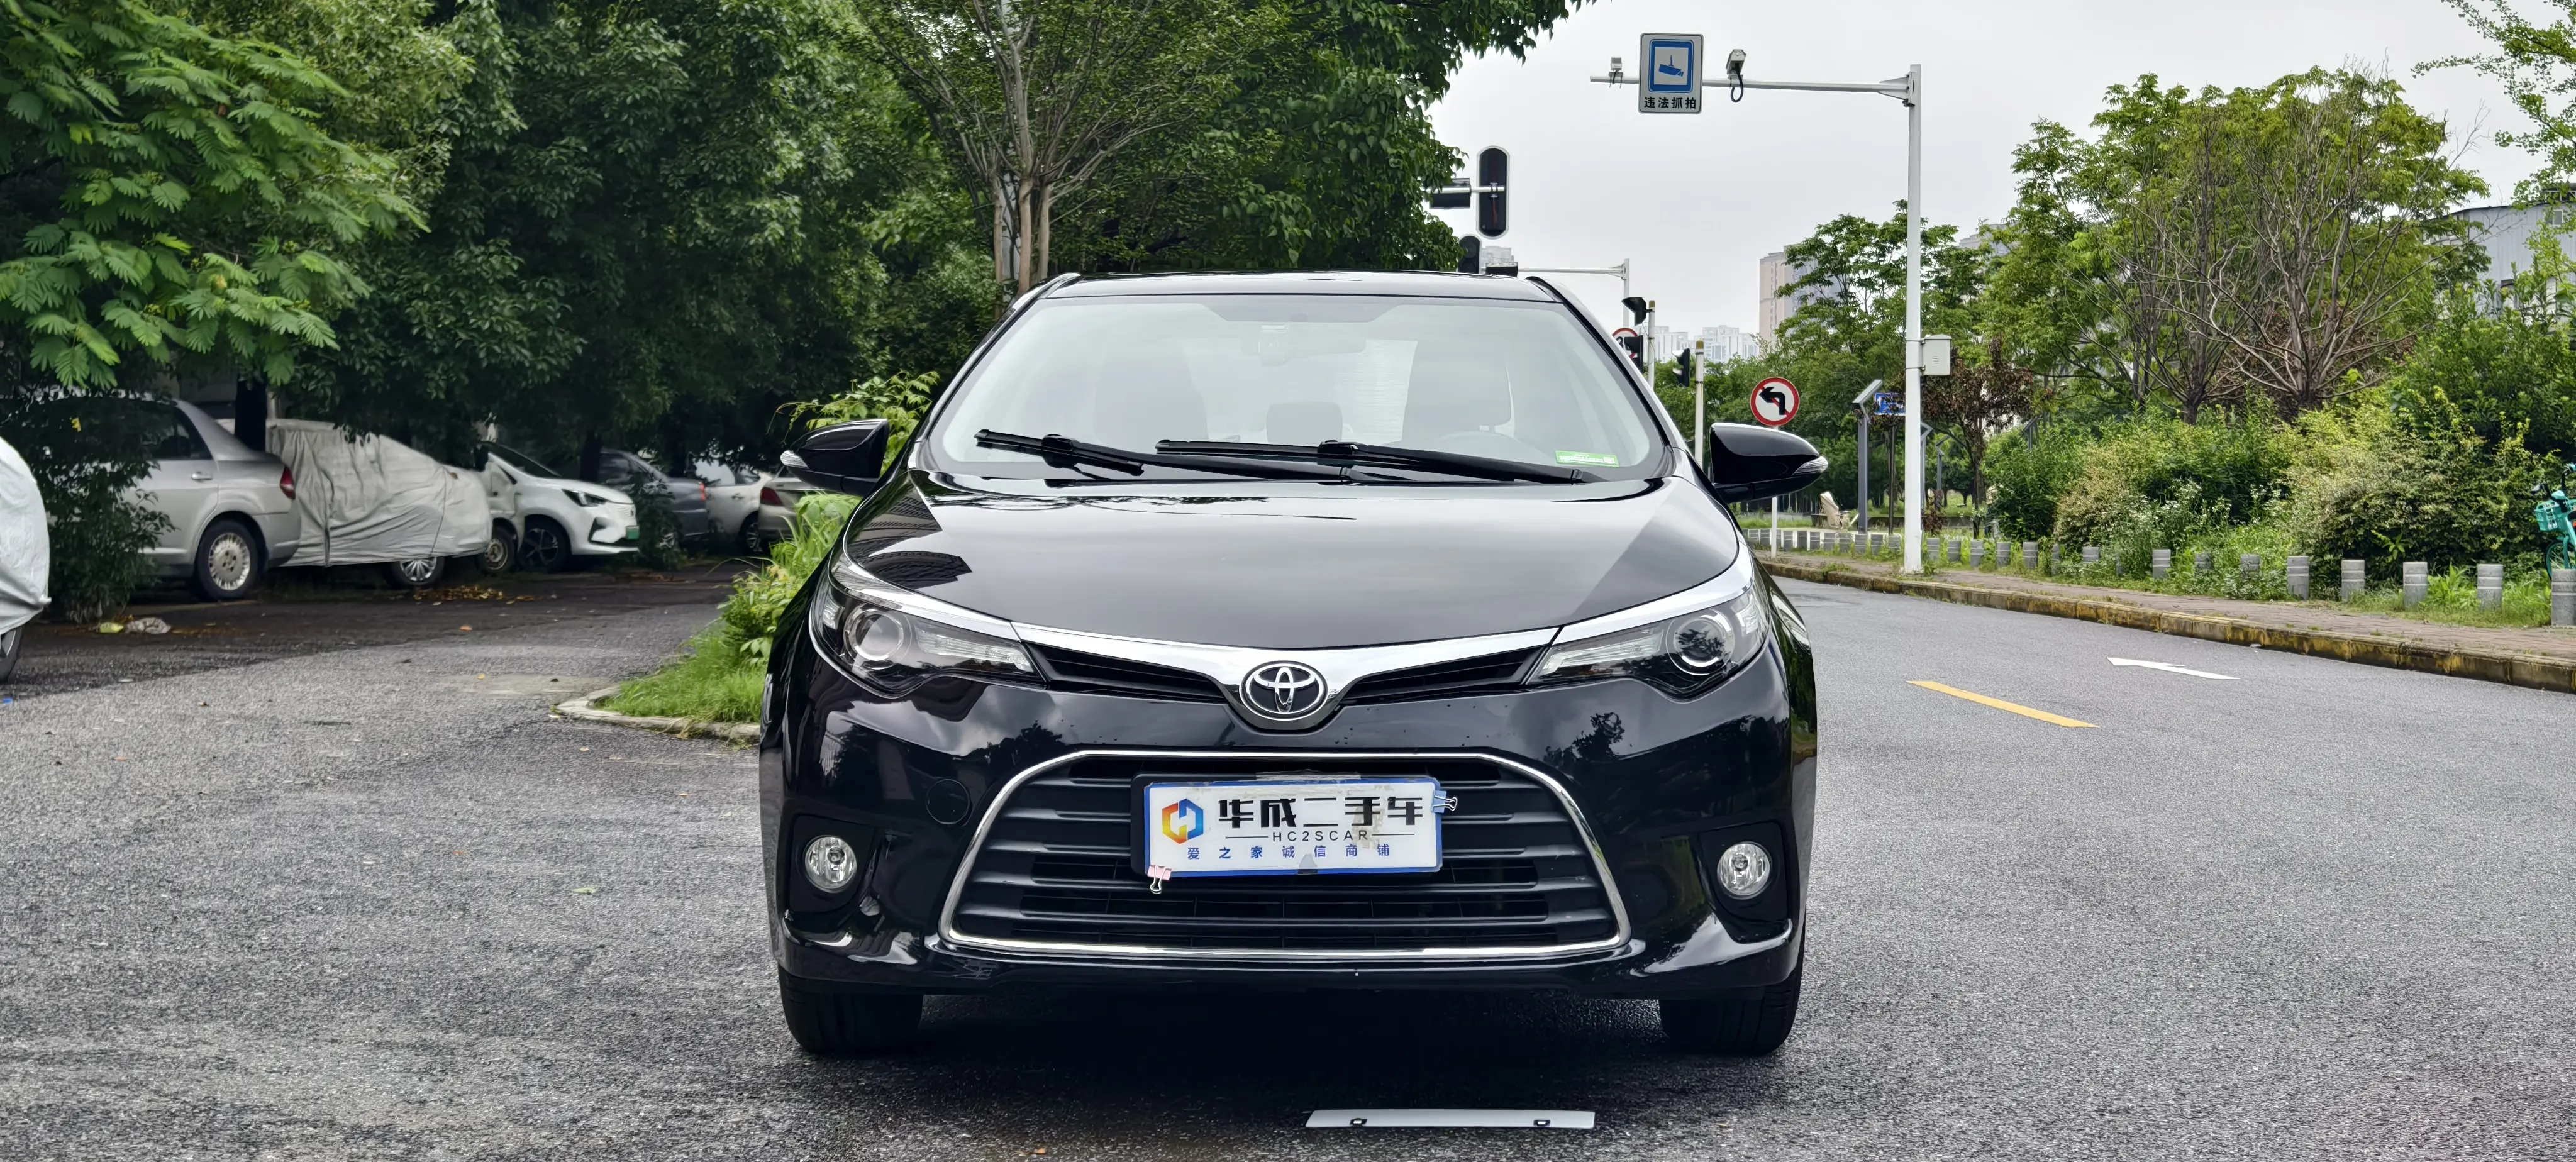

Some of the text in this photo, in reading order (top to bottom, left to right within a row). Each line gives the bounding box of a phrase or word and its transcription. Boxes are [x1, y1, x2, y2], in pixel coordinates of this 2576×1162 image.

[1644, 96, 1697, 109] 违法抓拍
[1218, 796, 1423, 829] 华成二手车
[1272, 830, 1368, 842] HC2SCAR
[1187, 844, 1389, 860] 爱之家诚信商铺
